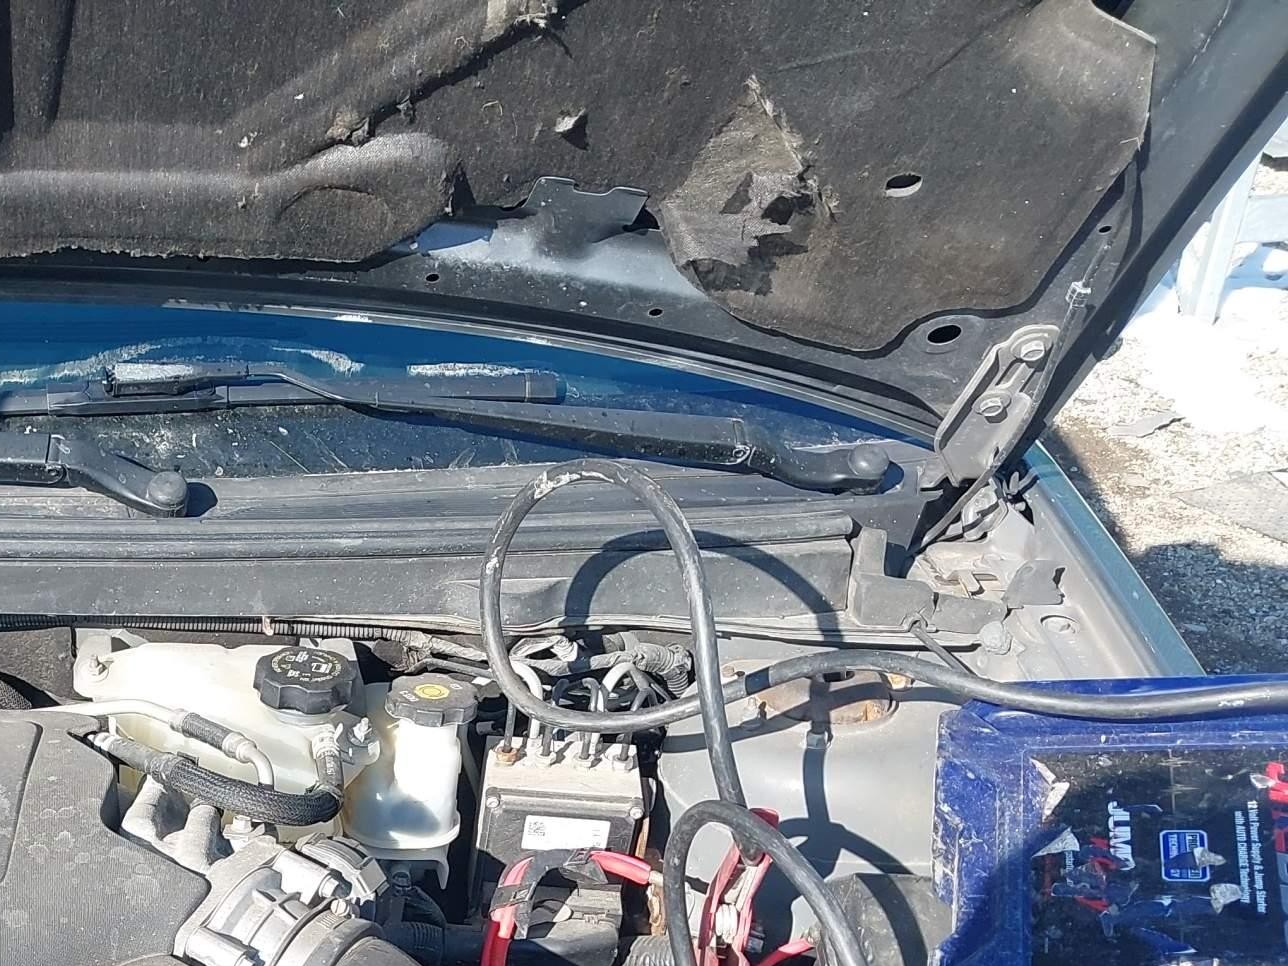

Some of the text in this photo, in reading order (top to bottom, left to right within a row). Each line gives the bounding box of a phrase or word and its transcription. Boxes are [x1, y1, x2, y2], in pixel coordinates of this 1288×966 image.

[1236, 825, 1247, 841] AUTO
[1249, 822, 1260, 841] Power
[1251, 842, 1263, 864] Supply
[1254, 872, 1265, 890] Jump
[1256, 890, 1267, 914] Starter
